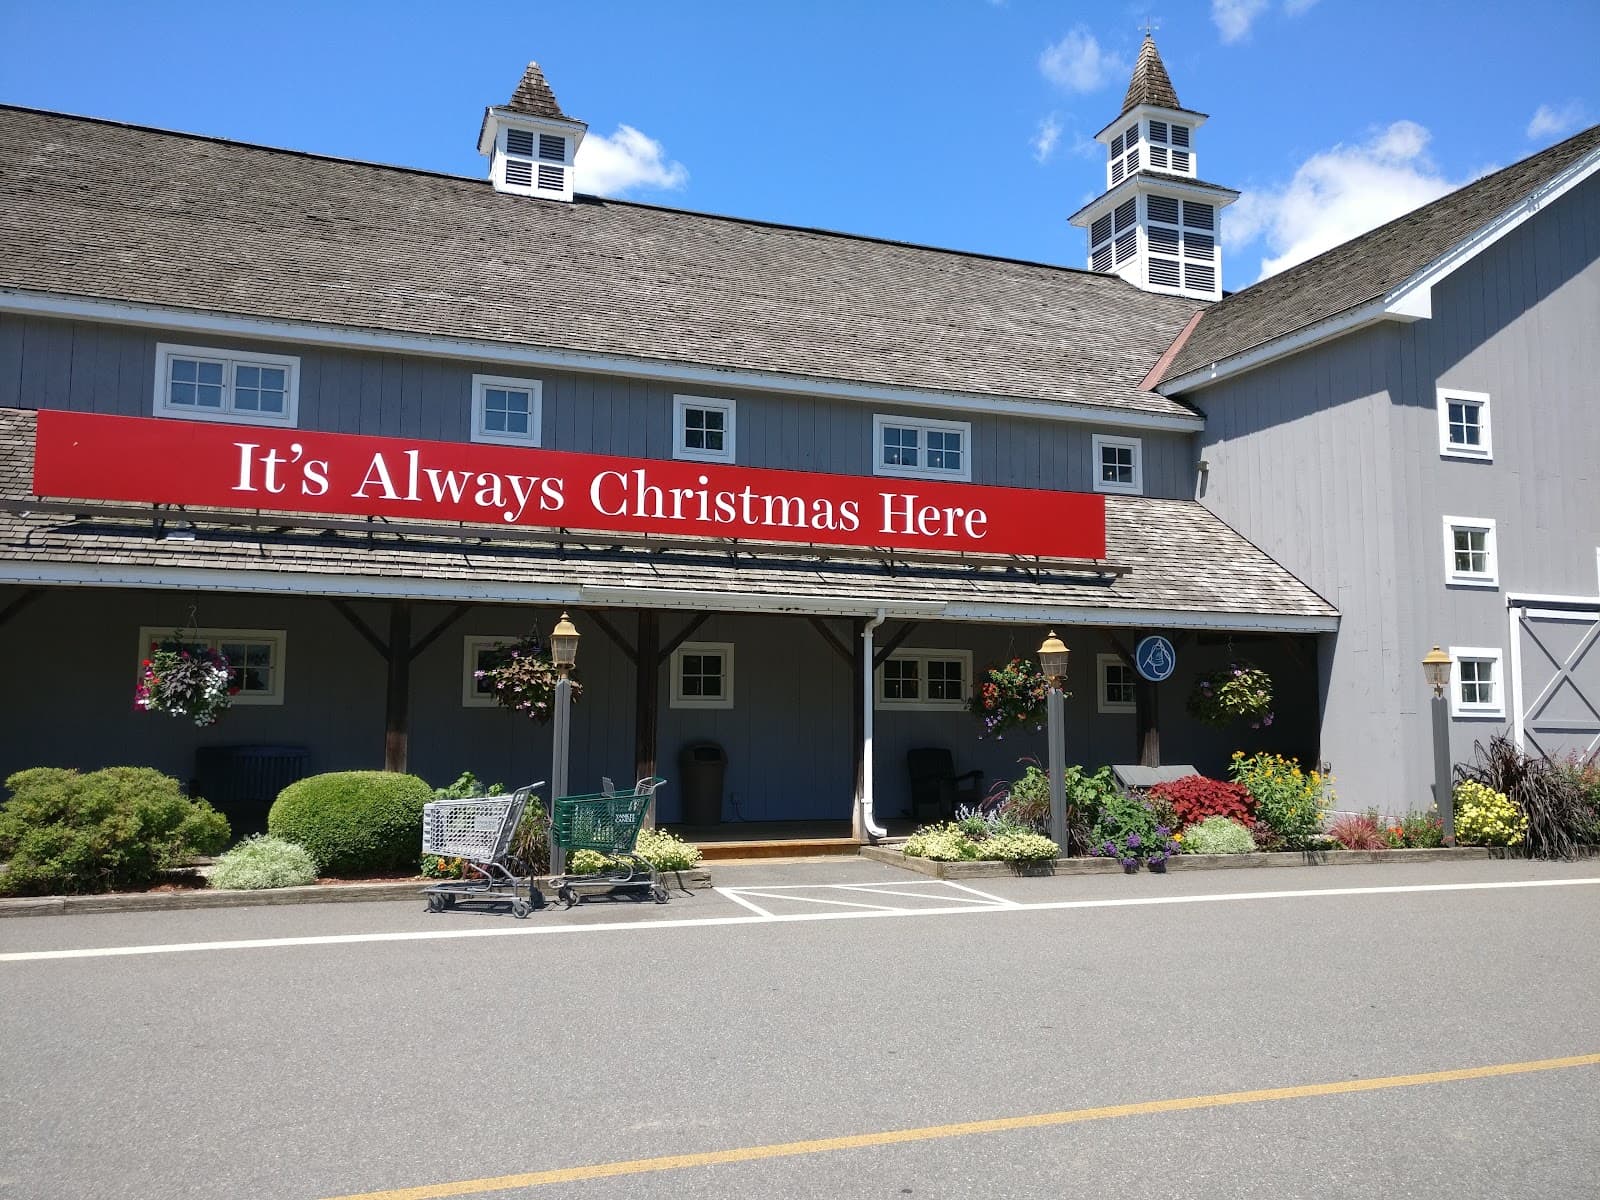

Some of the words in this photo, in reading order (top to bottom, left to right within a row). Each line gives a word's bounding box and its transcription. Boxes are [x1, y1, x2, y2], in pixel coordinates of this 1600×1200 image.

[232, 443, 329, 496] It's
[352, 449, 565, 523] Always
[591, 469, 861, 533] Christmas
[879, 493, 988, 540] Here
